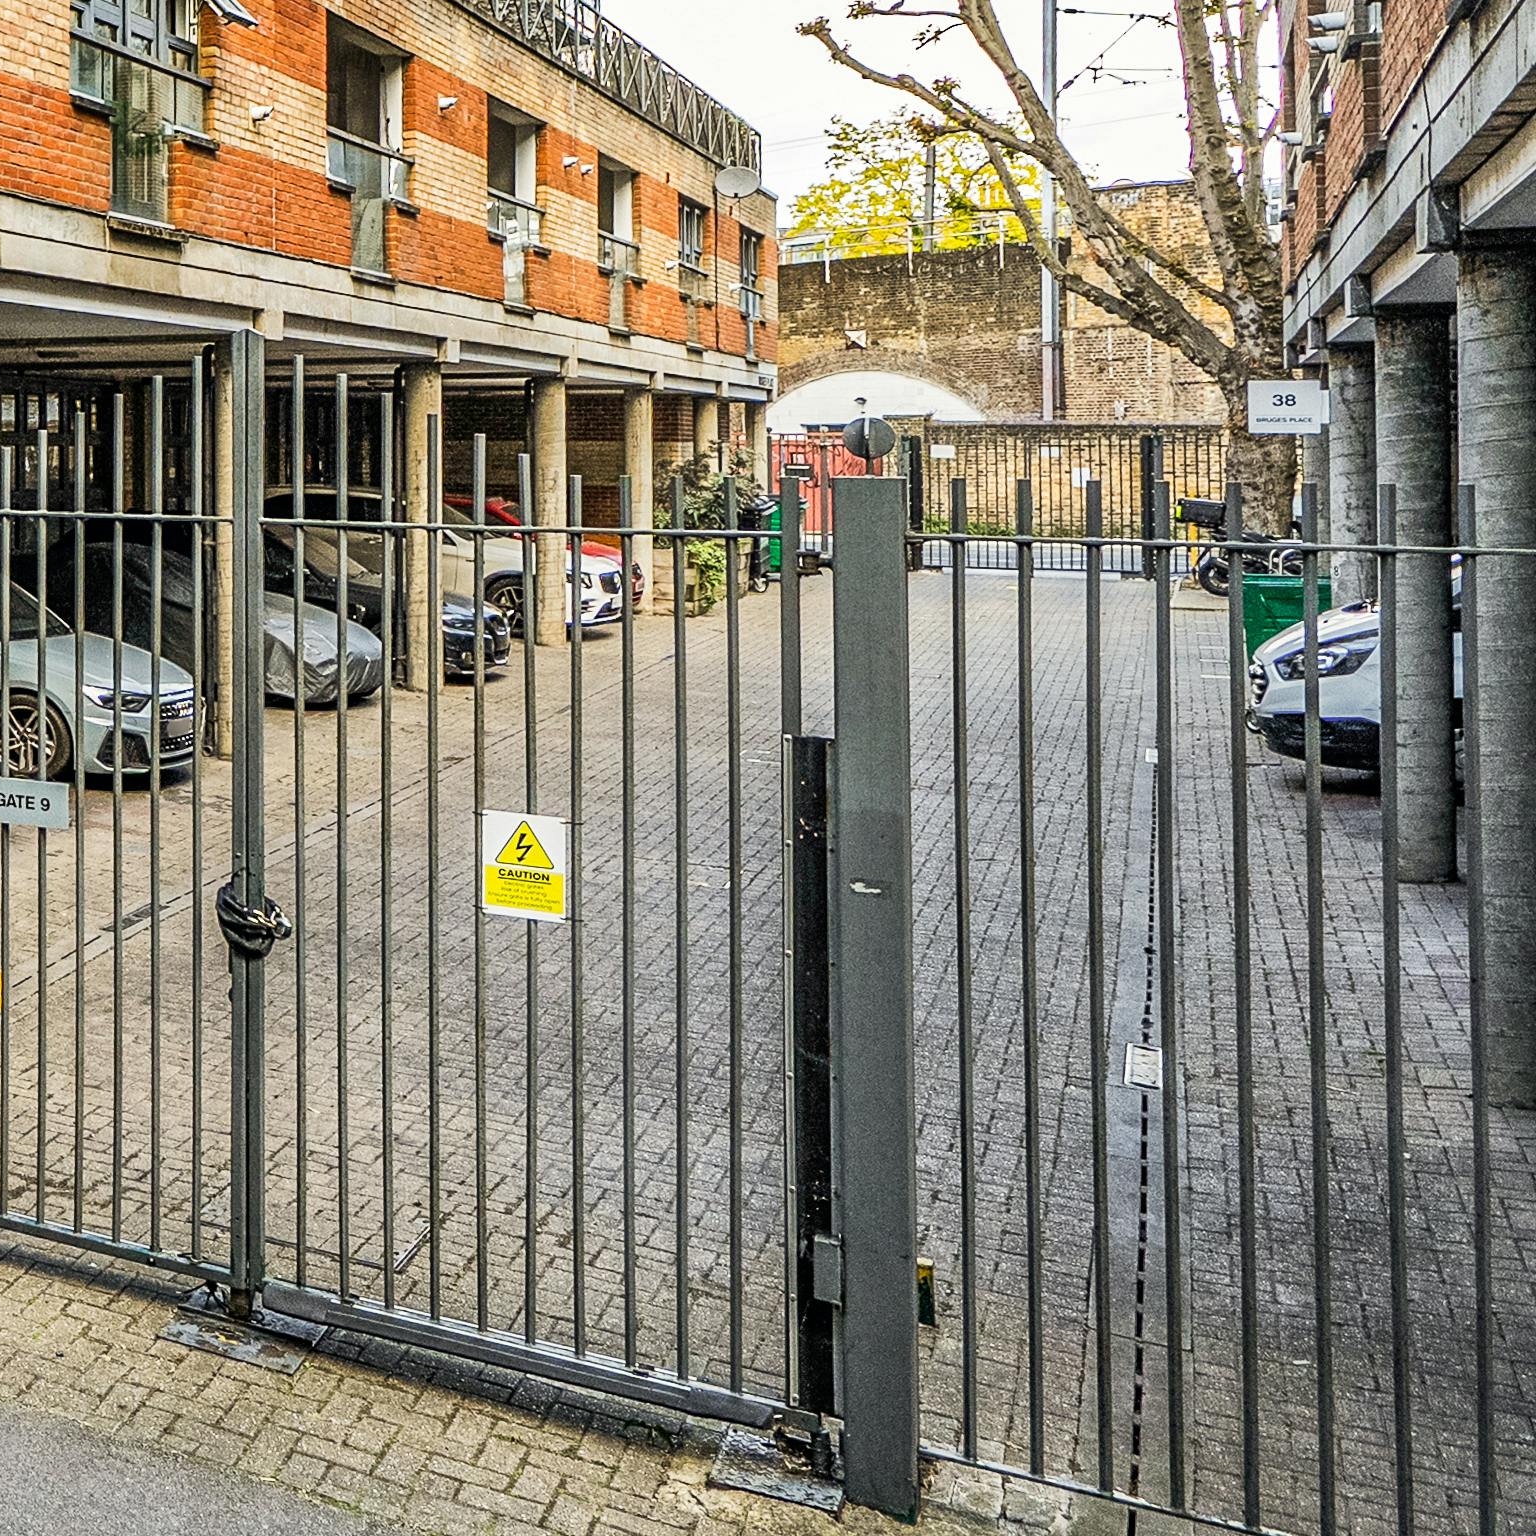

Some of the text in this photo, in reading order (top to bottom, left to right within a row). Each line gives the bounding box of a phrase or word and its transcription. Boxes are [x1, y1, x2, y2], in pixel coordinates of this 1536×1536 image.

[1272, 394, 1296, 407] 38
[40, 798, 51, 812] 9
[498, 868, 550, 882] CAUTION
